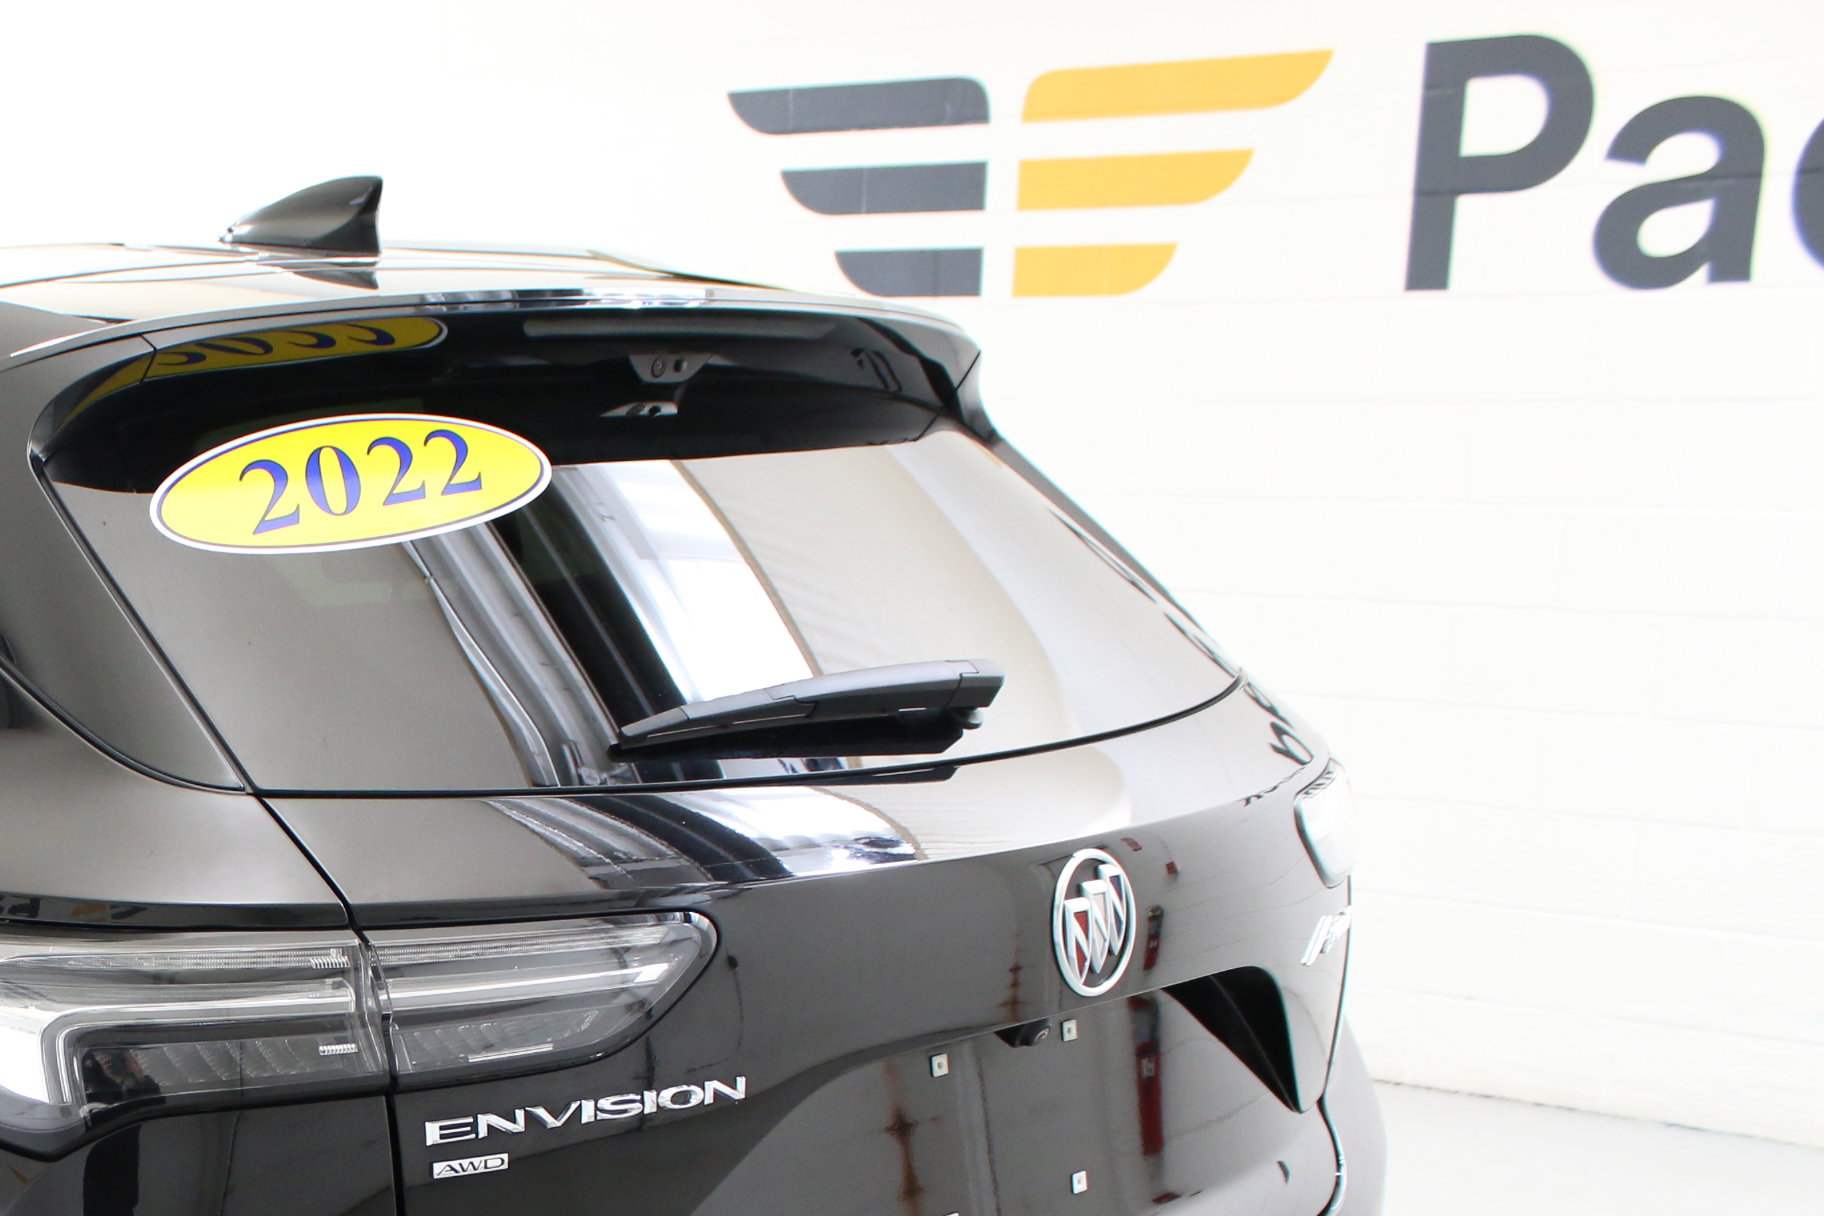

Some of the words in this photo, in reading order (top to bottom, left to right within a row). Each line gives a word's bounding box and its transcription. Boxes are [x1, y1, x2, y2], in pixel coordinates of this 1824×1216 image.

[1404, 33, 1824, 291] Pa
[239, 429, 482, 535] 2022
[425, 1076, 747, 1146] ENVISION
[434, 1154, 508, 1178] AWD
